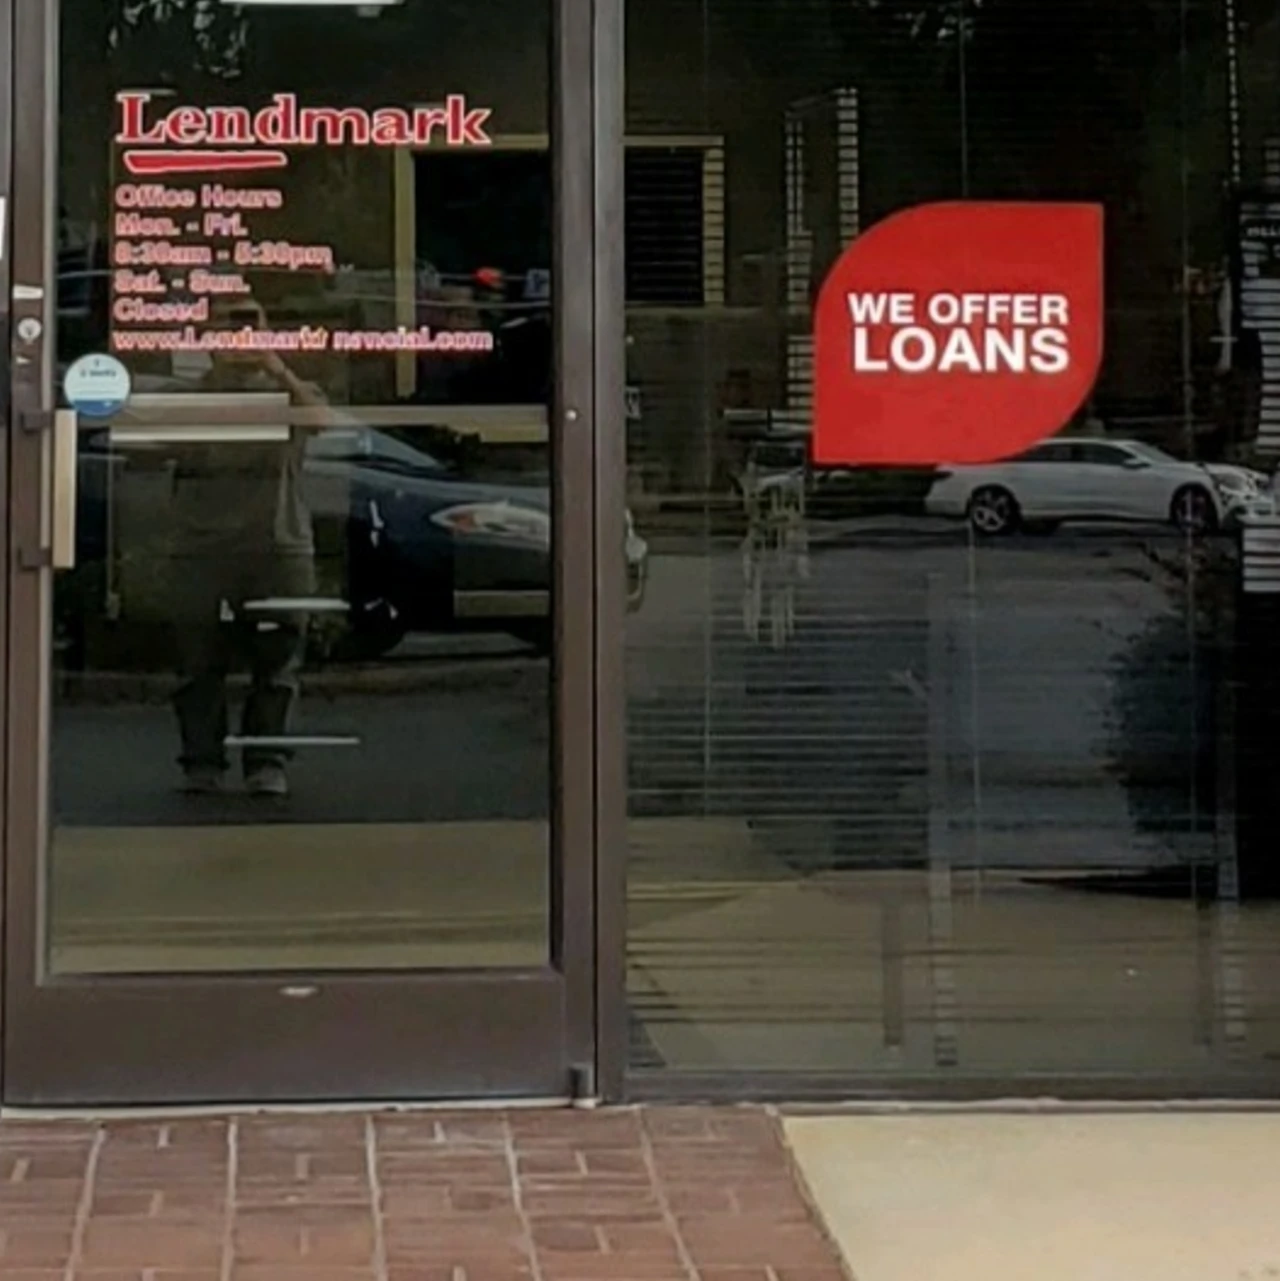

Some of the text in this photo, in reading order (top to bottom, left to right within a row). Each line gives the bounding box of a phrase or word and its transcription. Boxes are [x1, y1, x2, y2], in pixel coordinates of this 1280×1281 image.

[116, 93, 492, 145] Lendmark
[115, 184, 283, 208] Office Hours
[115, 212, 181, 236] Mon.
[203, 212, 248, 236] Fri.
[114, 297, 208, 321] Closed
[847, 292, 1069, 325] WE OFFER
[853, 326, 1070, 372] LOANS
